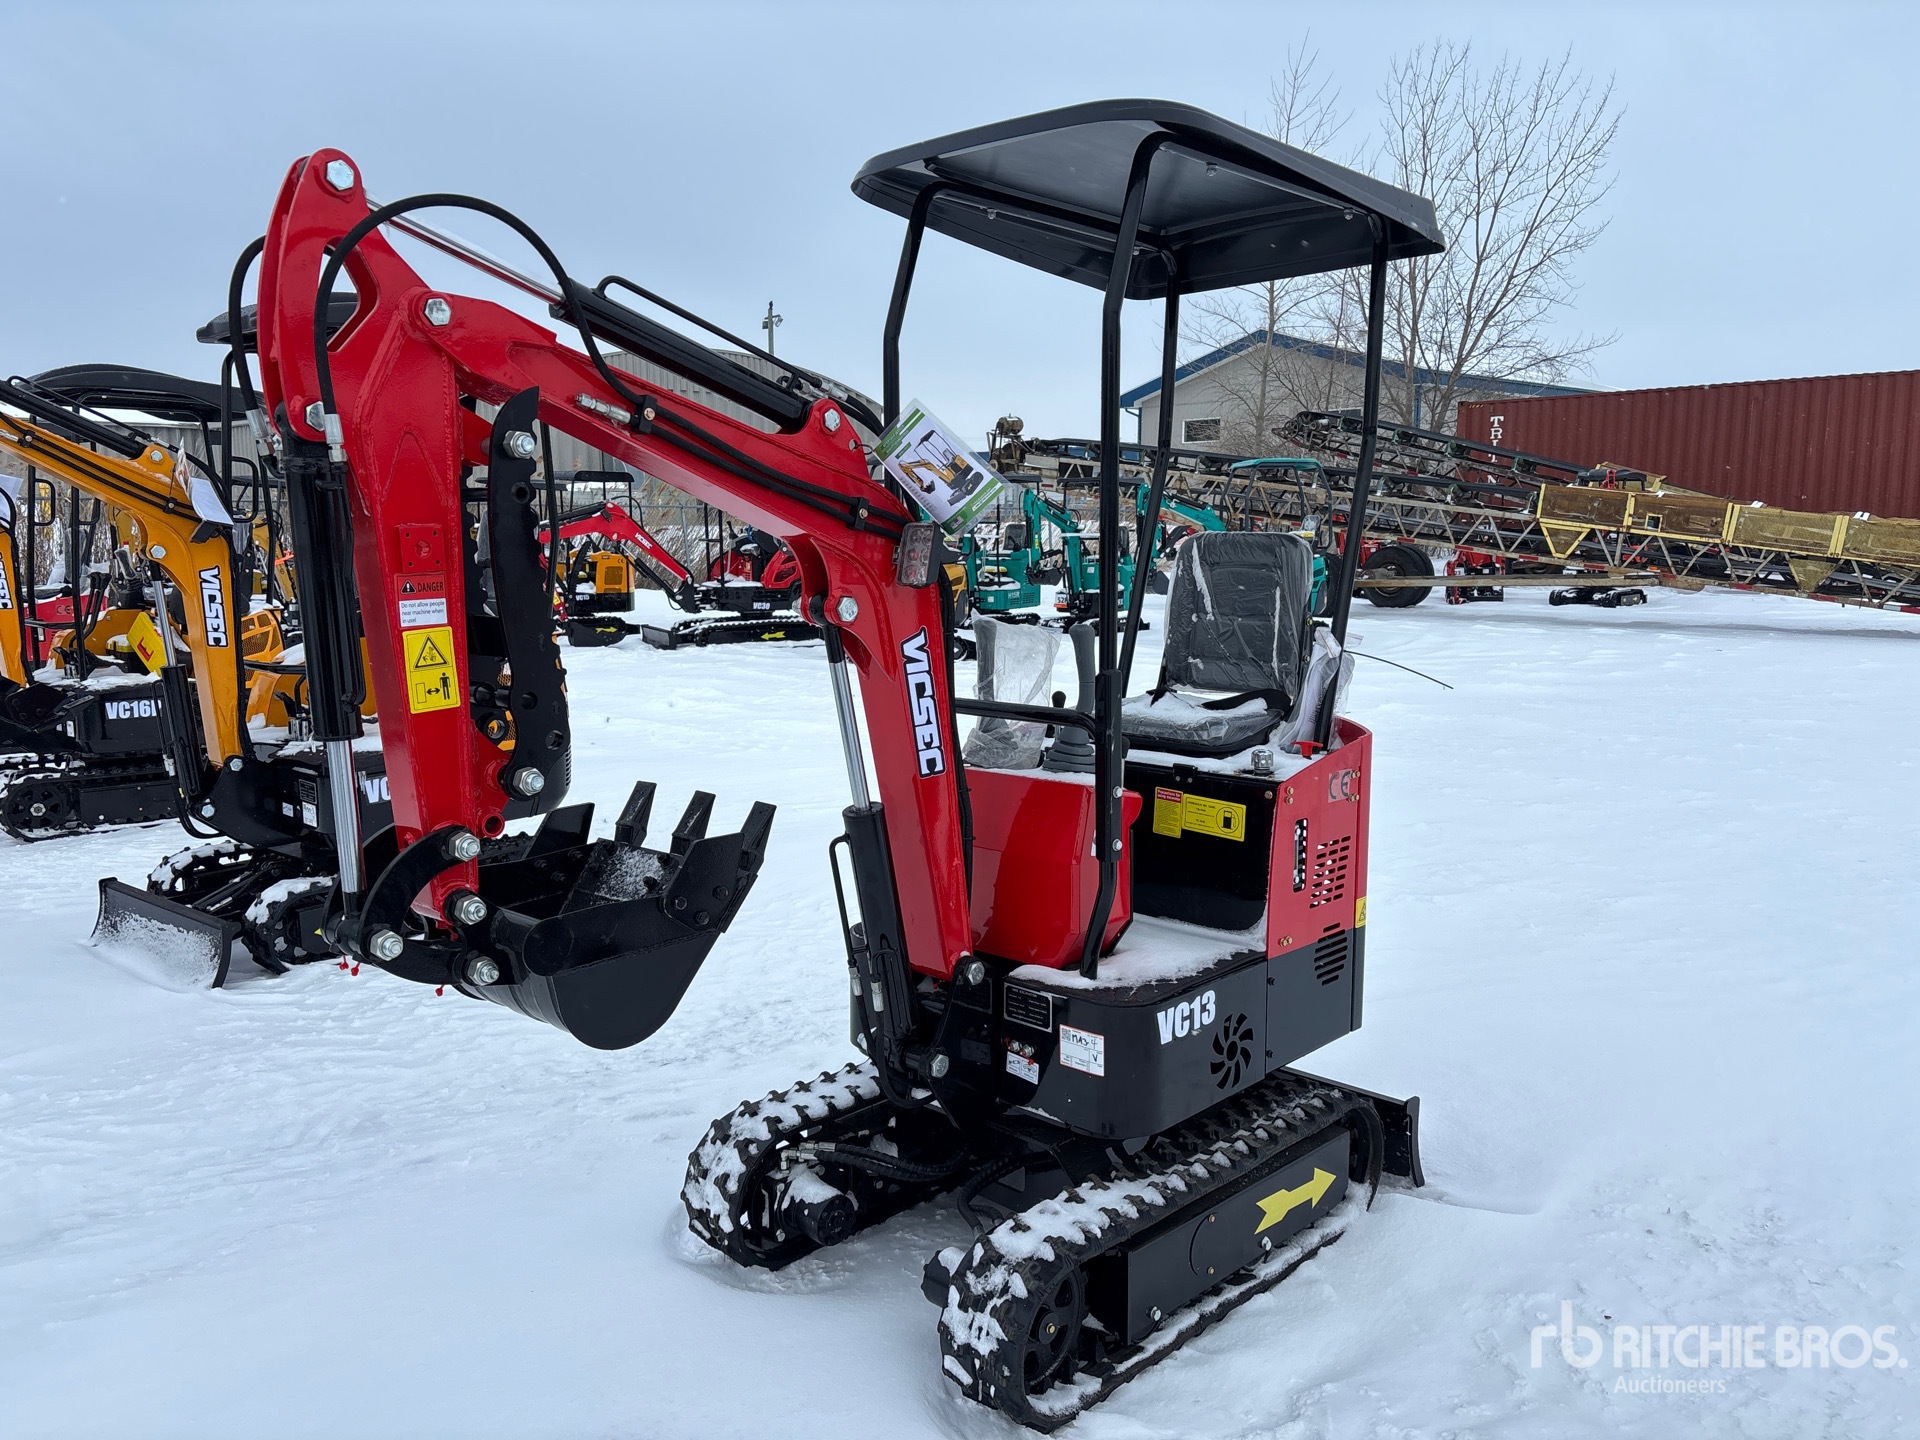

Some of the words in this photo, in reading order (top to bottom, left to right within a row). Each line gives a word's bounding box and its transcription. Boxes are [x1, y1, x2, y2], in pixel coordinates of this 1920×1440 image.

[199, 566, 228, 647] VICSEC
[417, 582, 444, 592] DANGER
[902, 628, 945, 777] VICSEC
[1329, 770, 1351, 800] CE
[1156, 989, 1216, 1045] VC13
